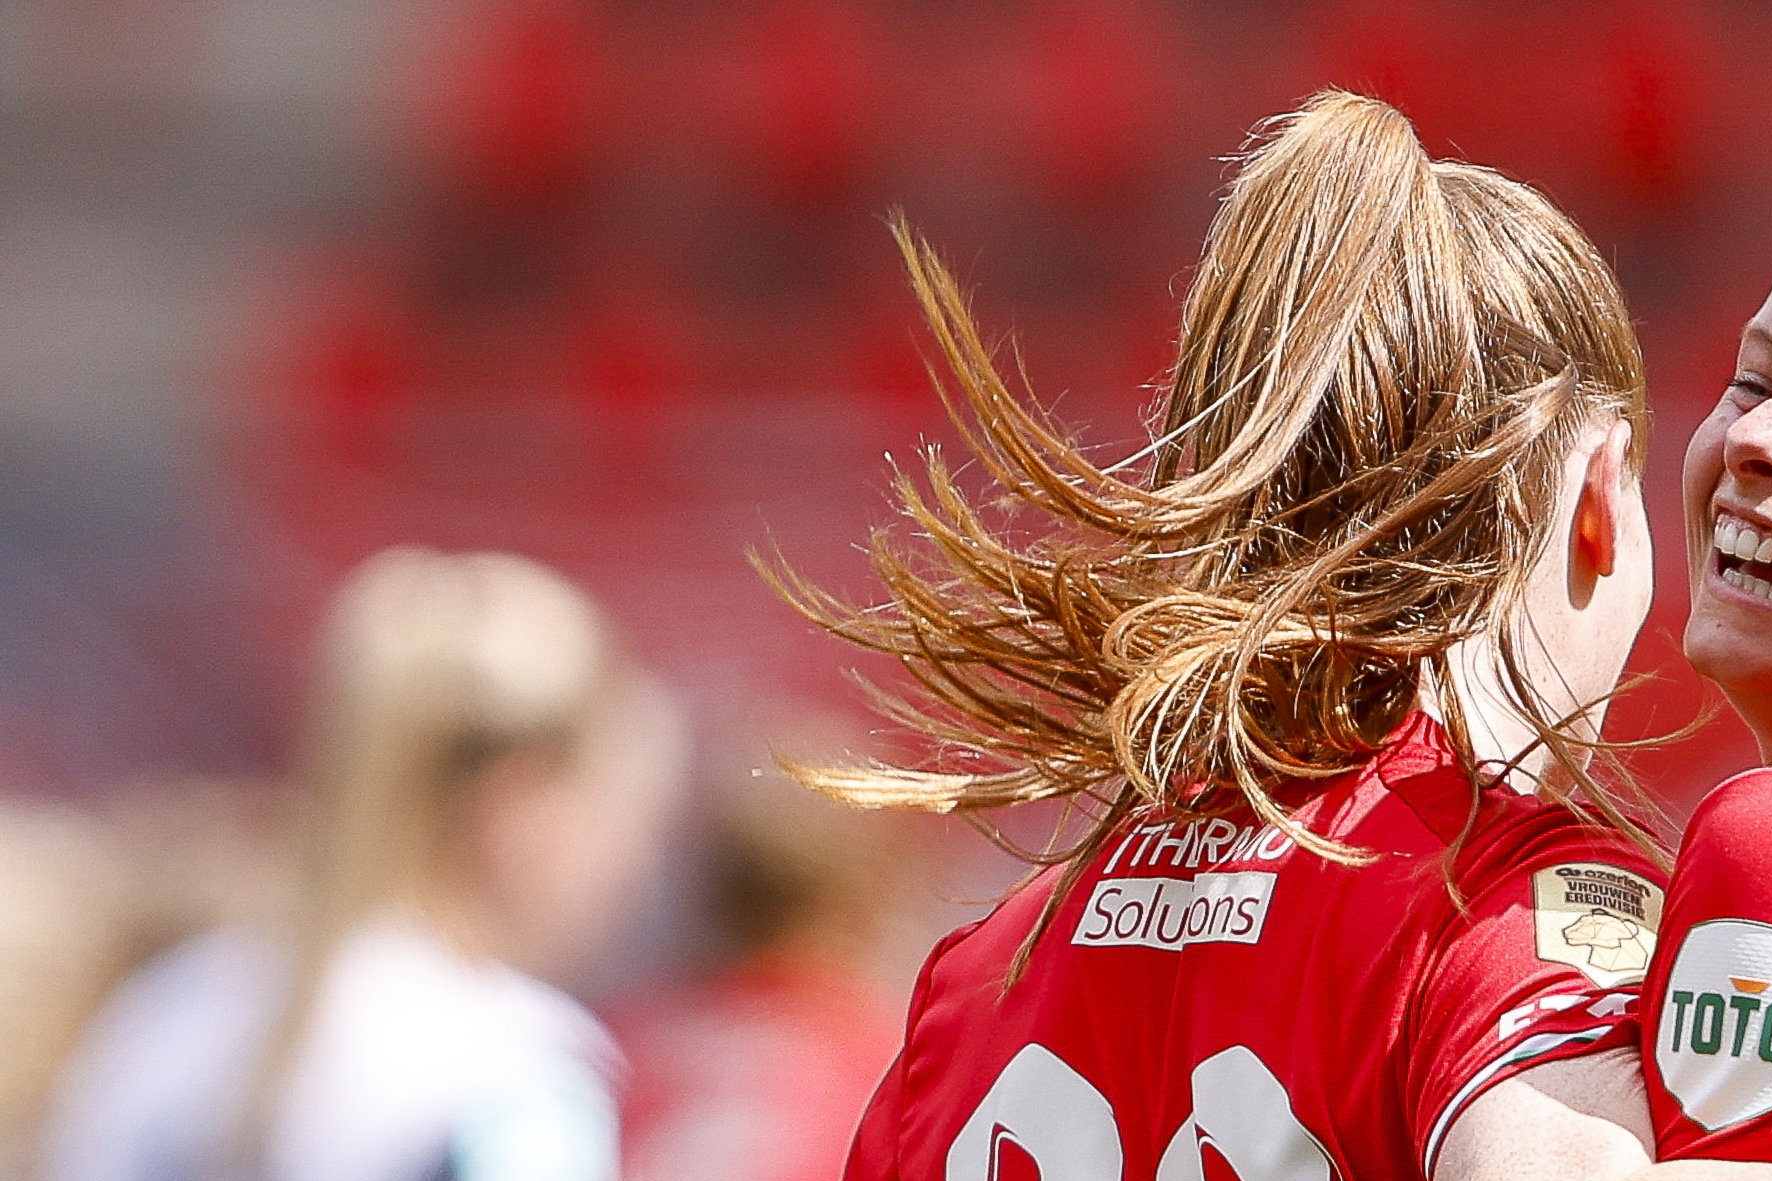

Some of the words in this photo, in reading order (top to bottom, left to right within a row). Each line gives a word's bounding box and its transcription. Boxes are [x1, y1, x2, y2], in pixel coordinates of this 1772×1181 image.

[1565, 891, 1646, 921] EREDIVISIE
[1567, 881, 1642, 907] VROUWEN
[1083, 883, 1260, 944] Soluons
